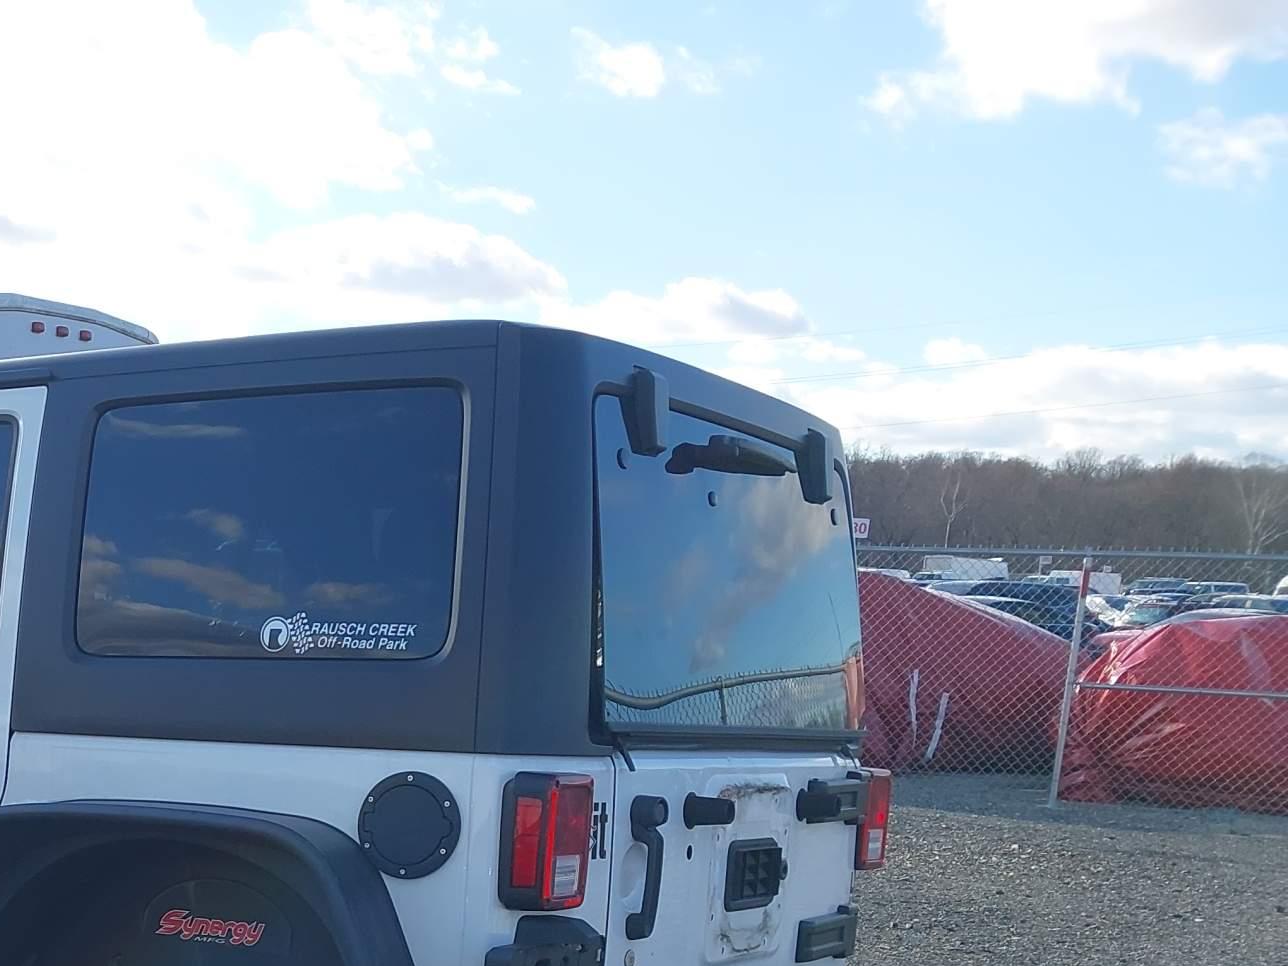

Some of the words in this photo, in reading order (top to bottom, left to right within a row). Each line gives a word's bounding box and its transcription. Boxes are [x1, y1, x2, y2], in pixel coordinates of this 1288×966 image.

[311, 623, 366, 635] RAUSCH
[369, 624, 417, 636] CREEK
[317, 636, 376, 649] Off-Road
[378, 638, 408, 650] Park
[155, 909, 266, 946] Synergy
